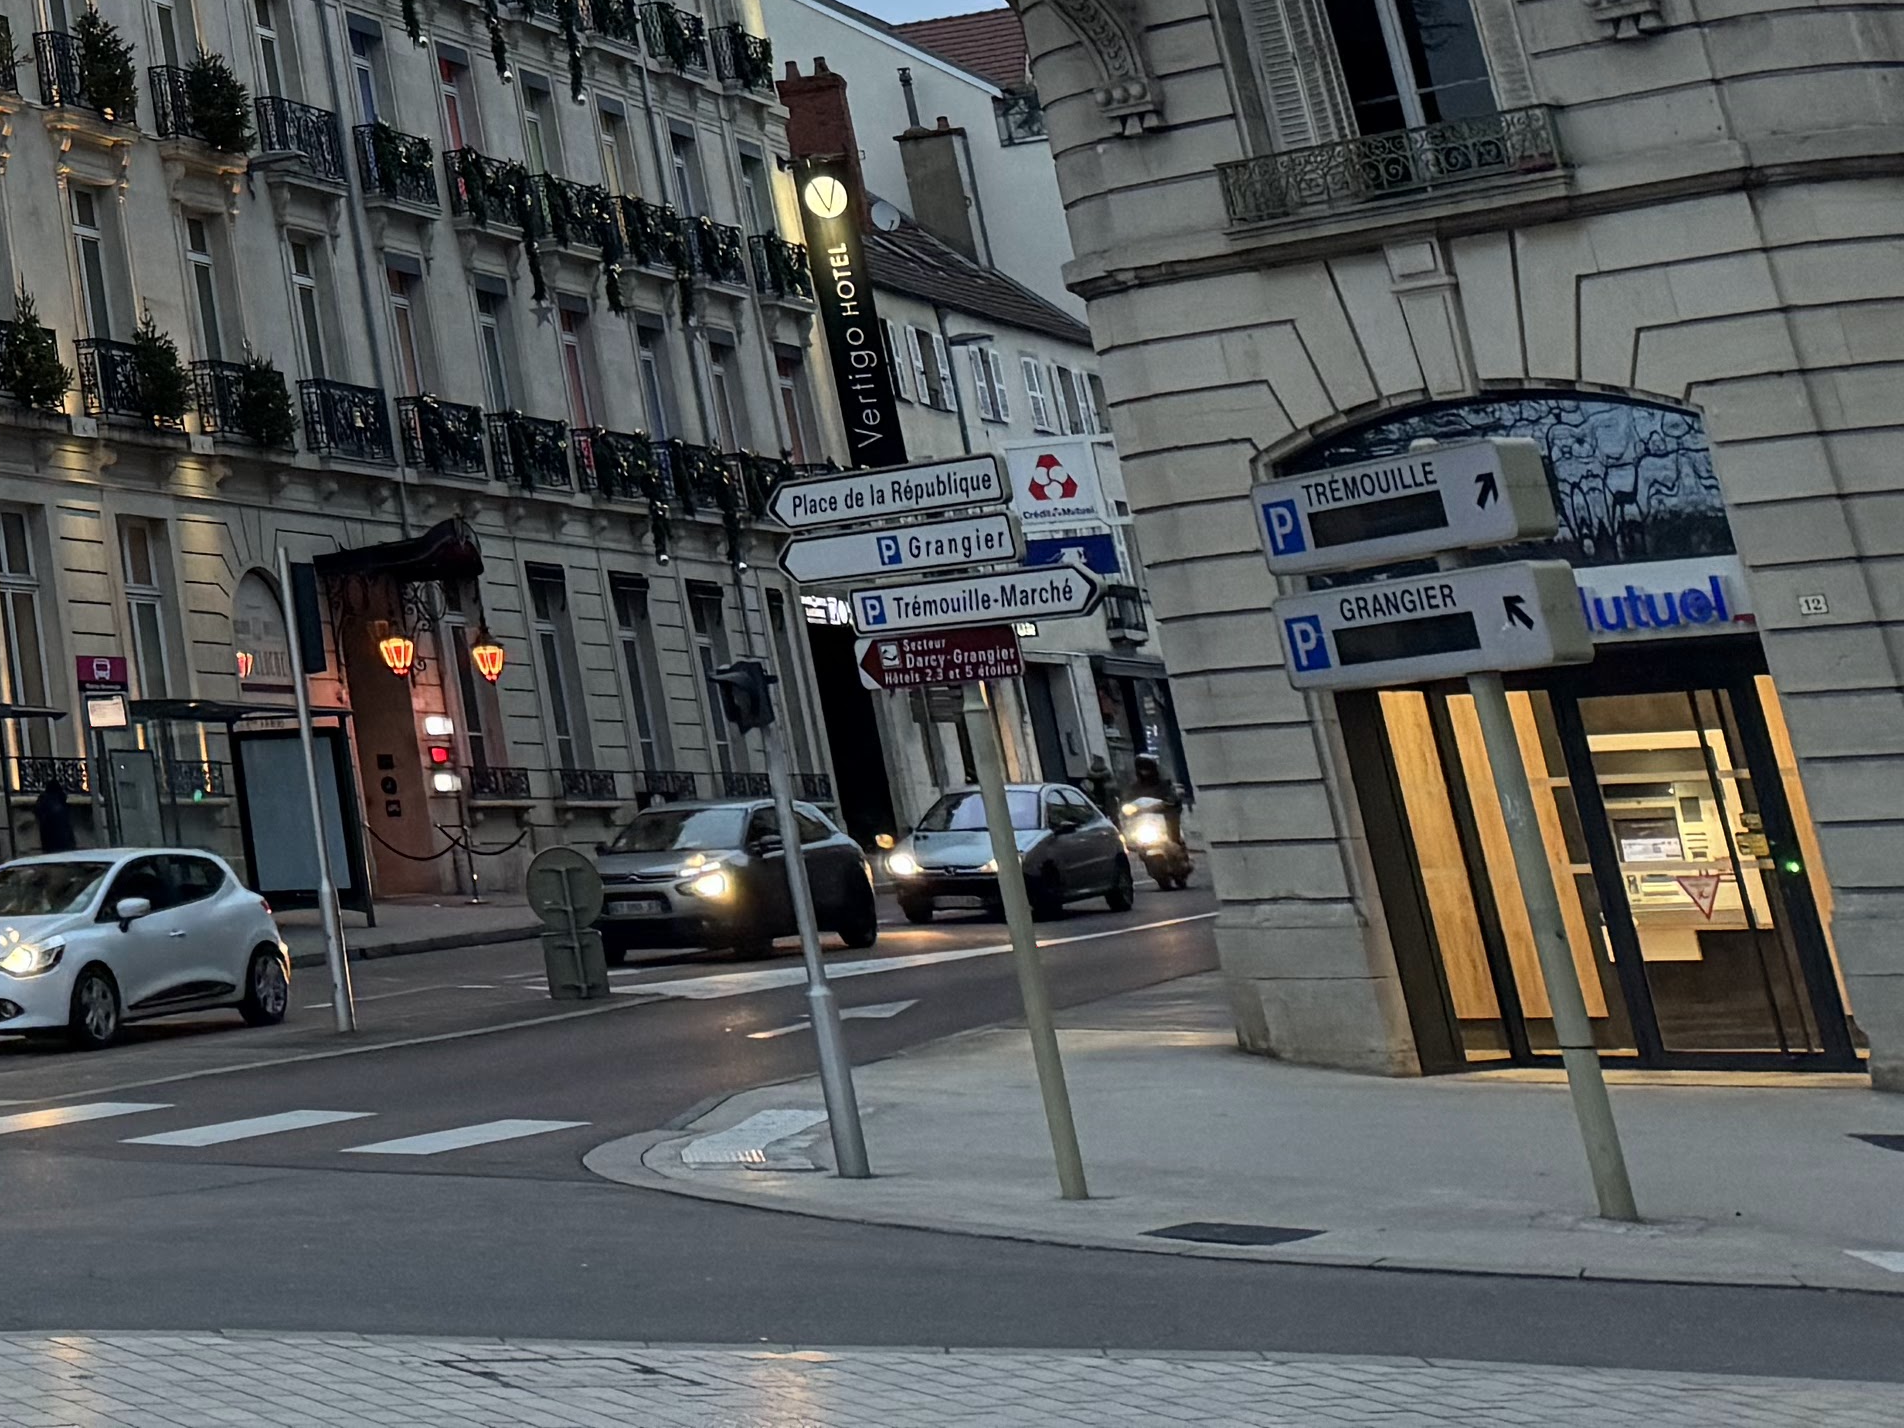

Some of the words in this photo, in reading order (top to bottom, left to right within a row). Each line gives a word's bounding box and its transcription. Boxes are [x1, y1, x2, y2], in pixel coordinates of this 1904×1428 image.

[828, 242, 860, 317] HOTEL
[845, 327, 884, 448] Vertigo
[792, 495, 838, 518] Place
[844, 487, 864, 510] de
[870, 484, 885, 506] la
[891, 471, 992, 505] République
[1301, 461, 1438, 508] TRÉMOUILLE
[879, 539, 896, 564] P
[908, 528, 1005, 559] Grangier
[1269, 506, 1293, 551] P
[866, 598, 881, 624] P
[892, 577, 1073, 620] Trémouille-Marché
[1339, 584, 1457, 622] GRANGIER
[1804, 598, 1821, 612] 12
[902, 637, 946, 652] Secteur
[905, 645, 1016, 669] Darcy-Grangier
[1291, 621, 1317, 667] P
[884, 670, 921, 685] Hôtels
[949, 668, 961, 680] et
[965, 665, 974, 678] 5
[978, 661, 1020, 677] étoiles
